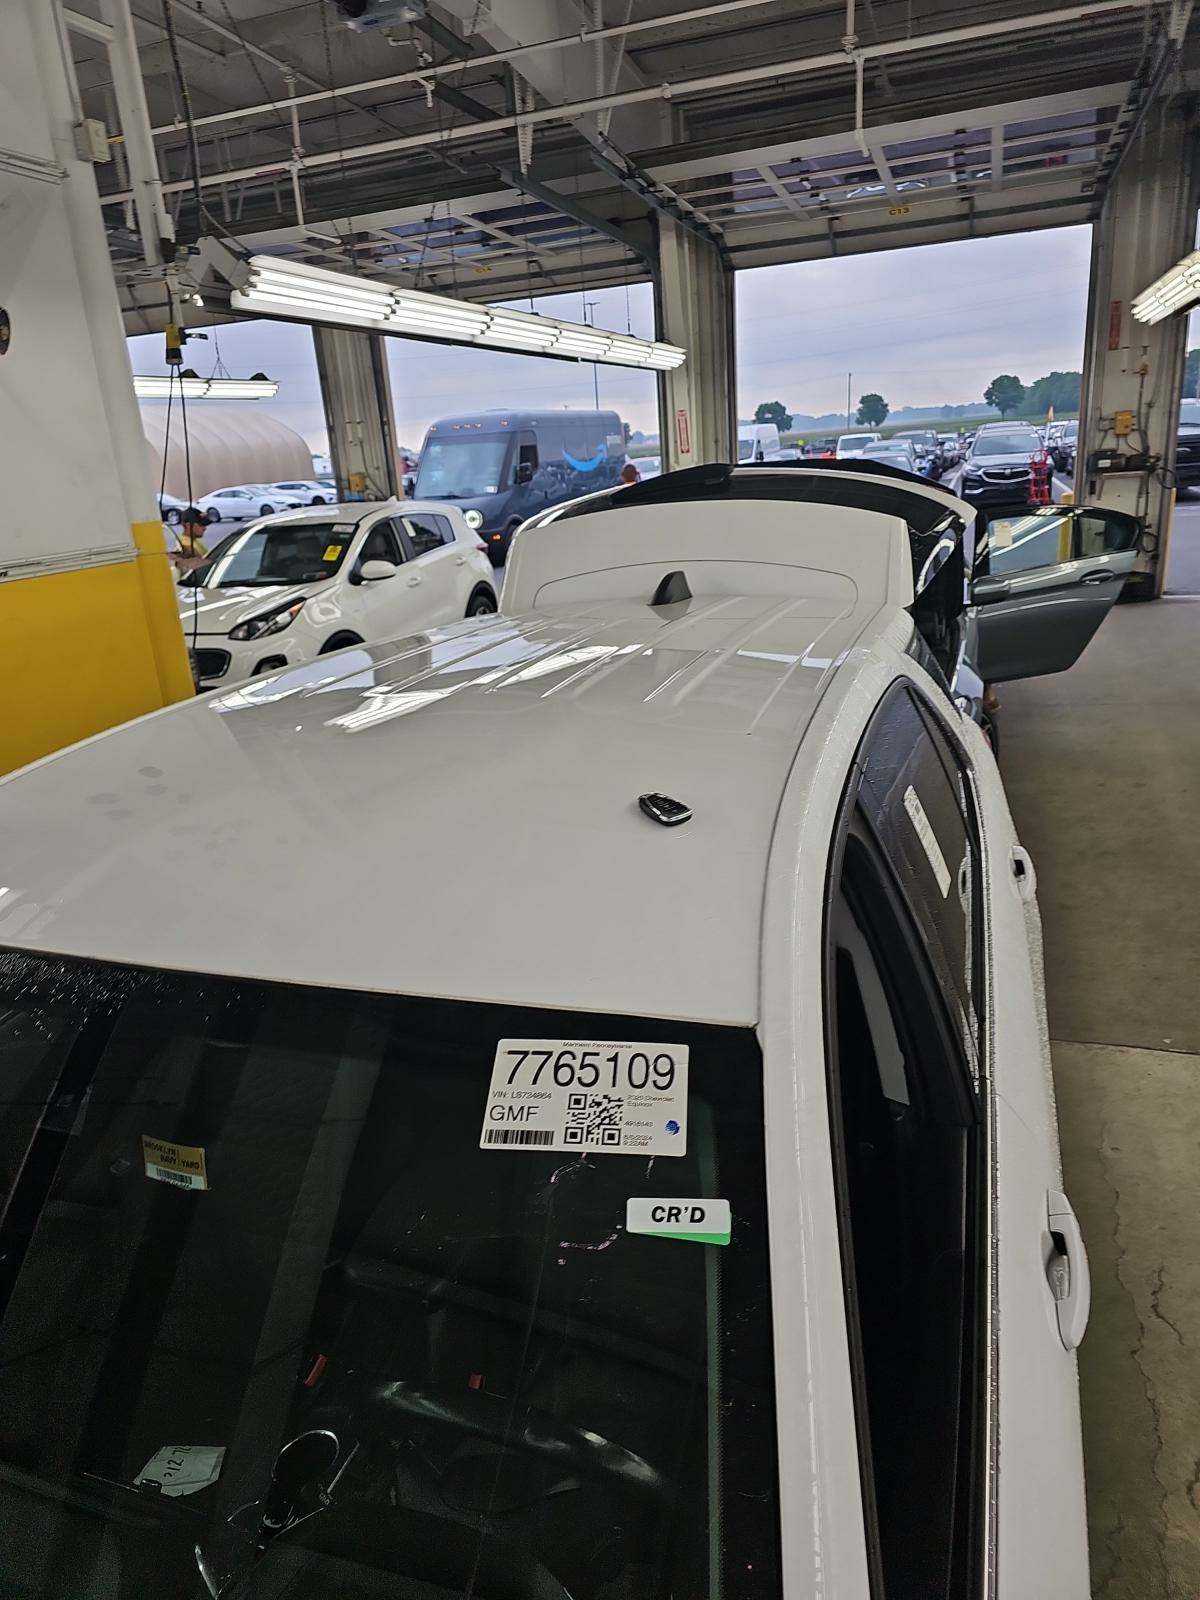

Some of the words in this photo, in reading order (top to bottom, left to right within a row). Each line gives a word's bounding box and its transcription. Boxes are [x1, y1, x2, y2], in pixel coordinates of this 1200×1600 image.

[889, 207, 910, 216] C13
[506, 1050, 676, 1091] 7765109
[489, 1104, 540, 1122] GMF
